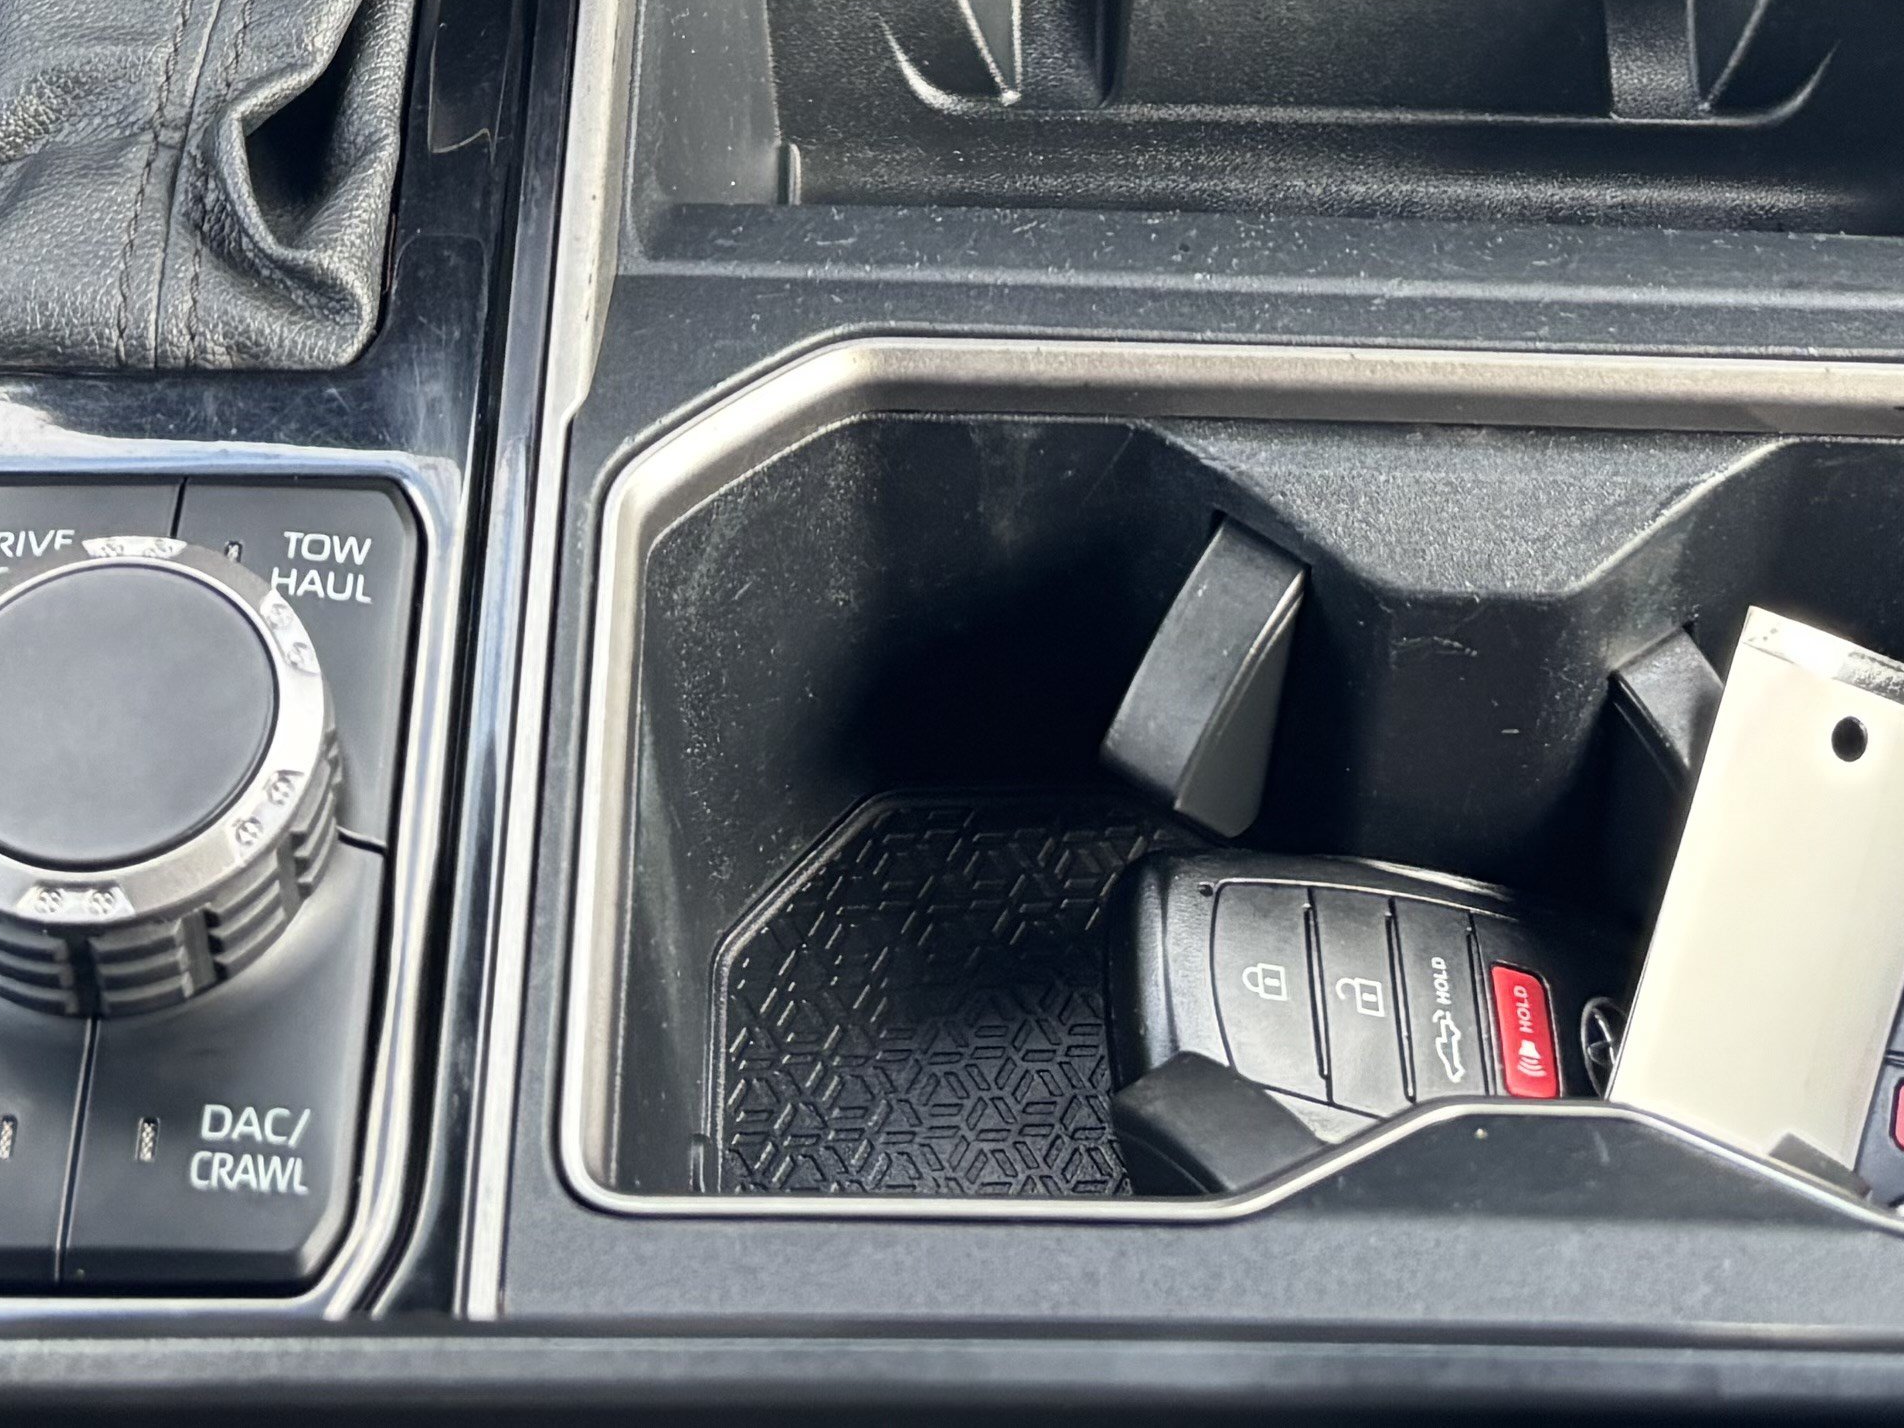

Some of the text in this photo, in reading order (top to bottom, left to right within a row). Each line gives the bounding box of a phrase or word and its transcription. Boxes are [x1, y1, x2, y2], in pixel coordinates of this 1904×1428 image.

[284, 532, 371, 565] TOW
[270, 567, 373, 605] HAUL
[1432, 957, 1451, 1004] HOLD
[1513, 985, 1534, 1034] HOLD
[202, 1105, 310, 1147] DAC/
[191, 1151, 307, 1194] CRAWL
